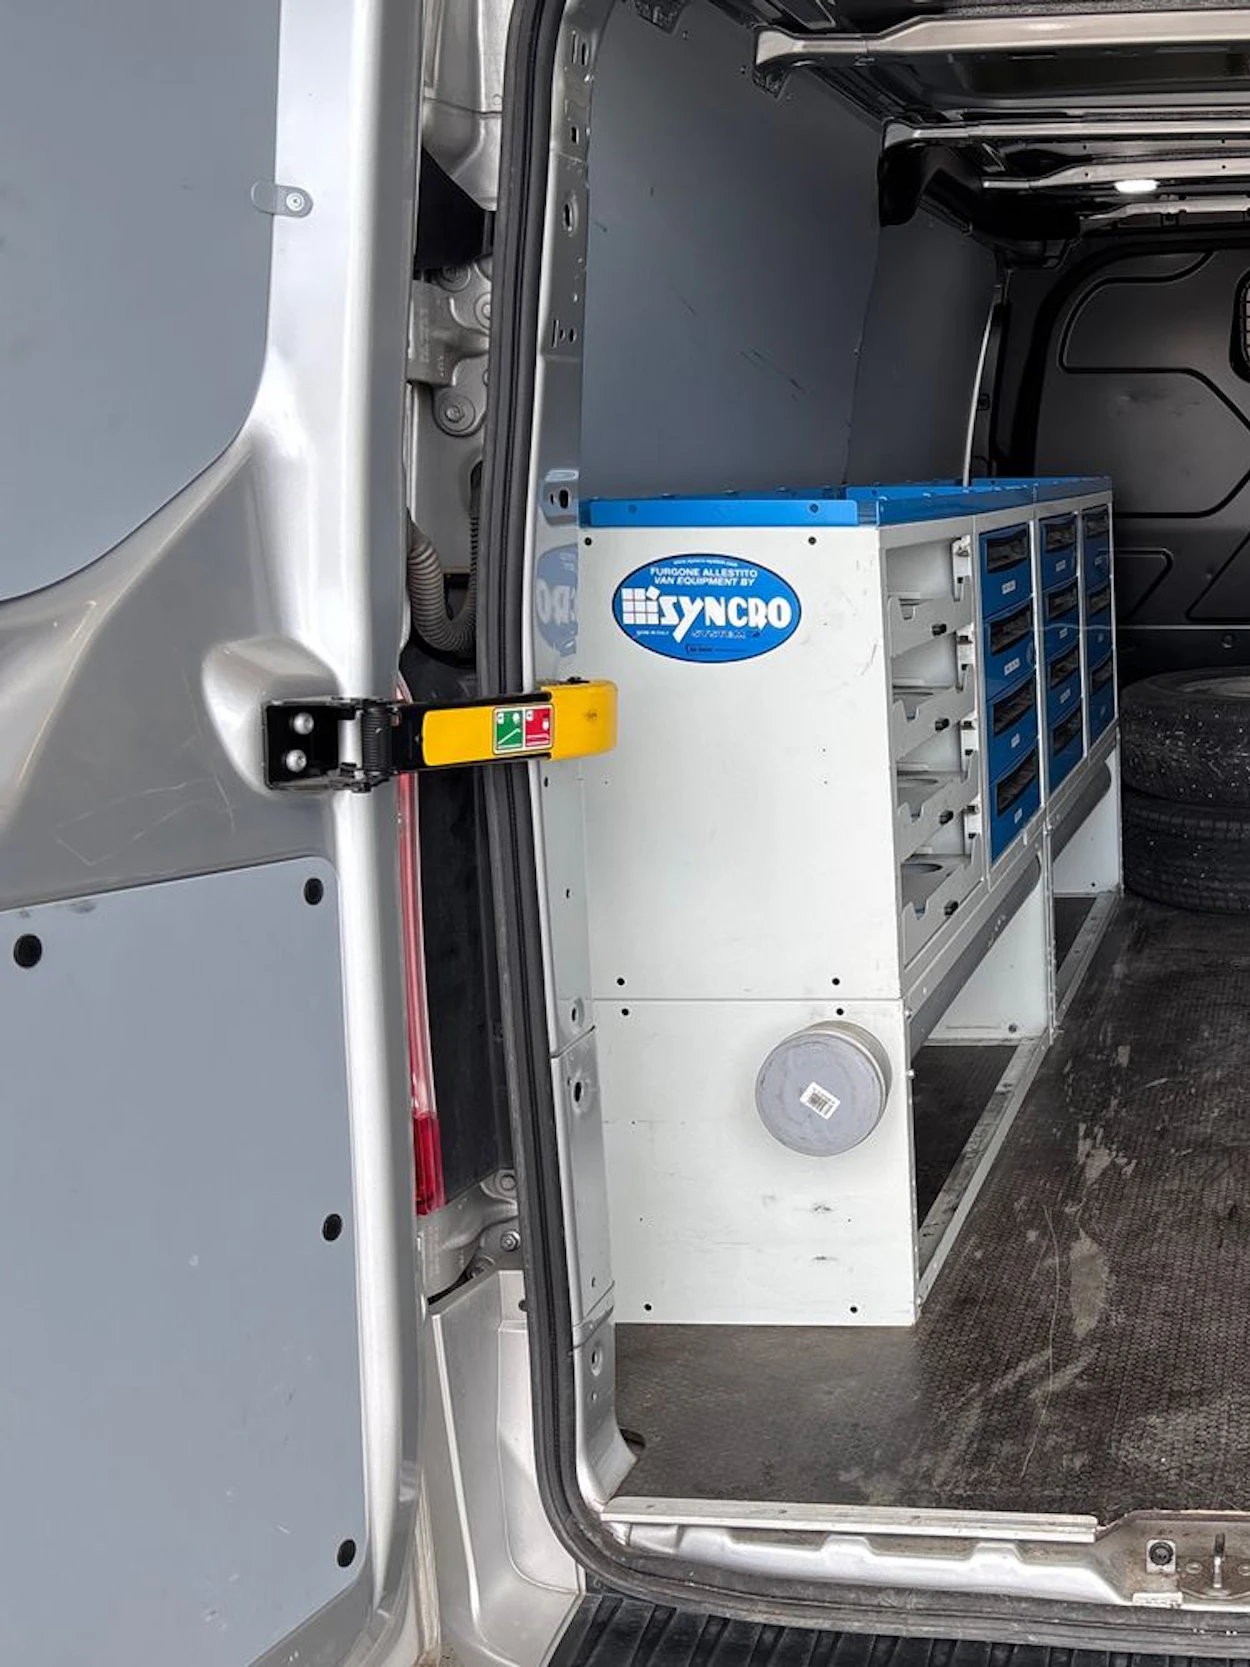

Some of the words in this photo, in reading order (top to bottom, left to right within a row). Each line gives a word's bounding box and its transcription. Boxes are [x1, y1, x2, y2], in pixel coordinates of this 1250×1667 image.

[650, 567, 700, 577] FURGONE
[702, 567, 758, 578] ALLESTITO
[654, 576, 675, 586] VAN
[676, 576, 738, 587] EQUIPMENT
[739, 577, 757, 588] BY
[659, 594, 793, 644] SYNCRO
